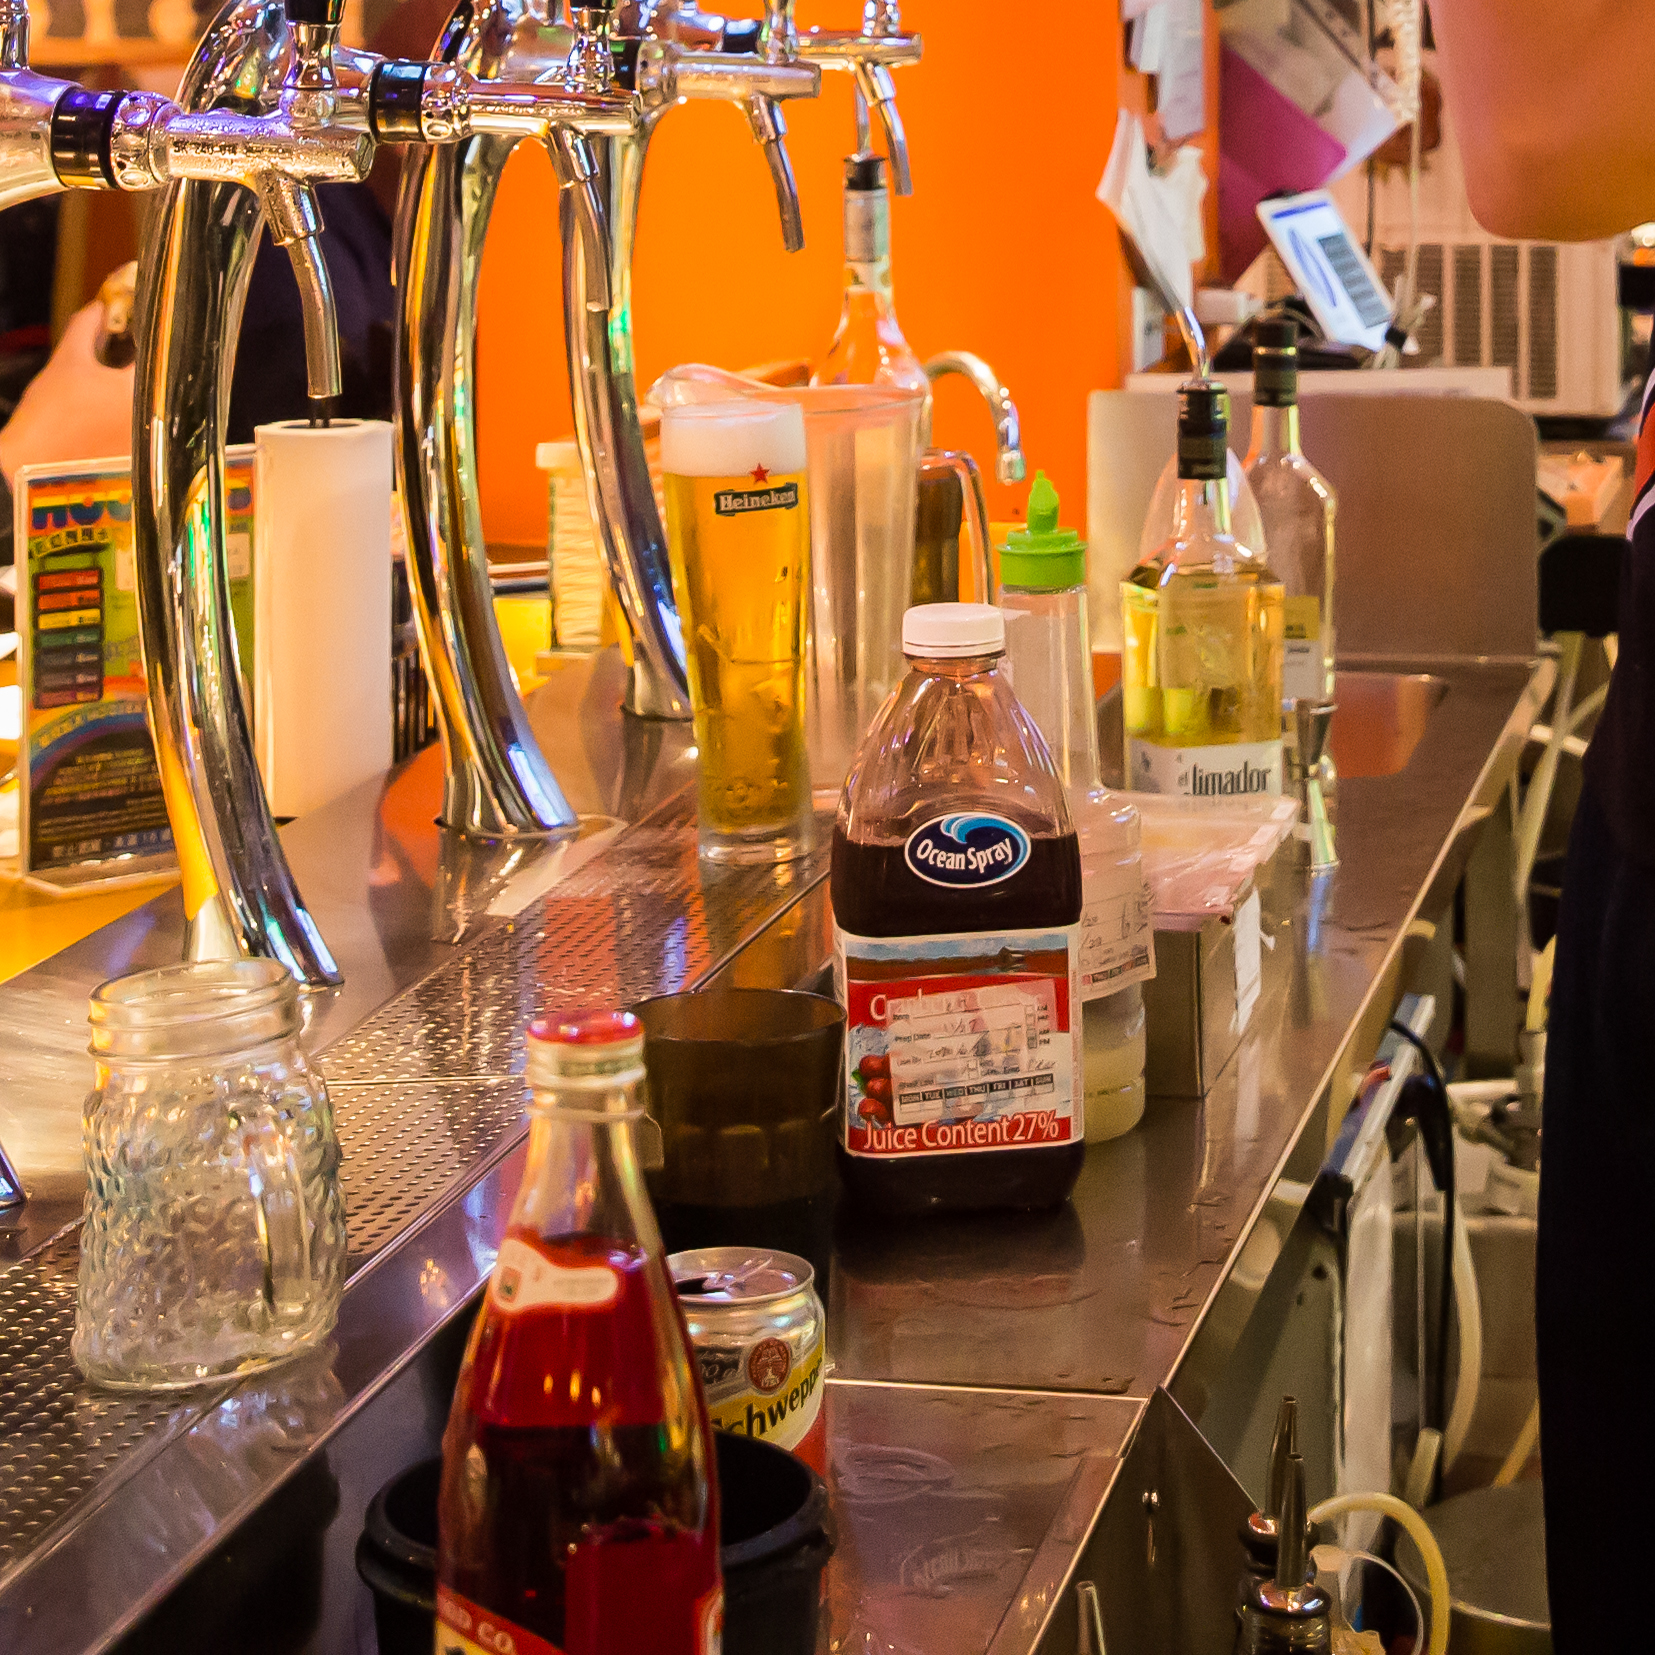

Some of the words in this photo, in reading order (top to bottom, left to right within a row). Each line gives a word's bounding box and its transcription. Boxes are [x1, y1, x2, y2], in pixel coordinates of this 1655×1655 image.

[719, 489, 796, 511] Heineken
[915, 838, 966, 870] Ocean
[967, 838, 1013, 874] Spray
[864, 1120, 917, 1150] Juice
[921, 1118, 1010, 1148] Content
[1012, 1109, 1060, 1141] 27%
